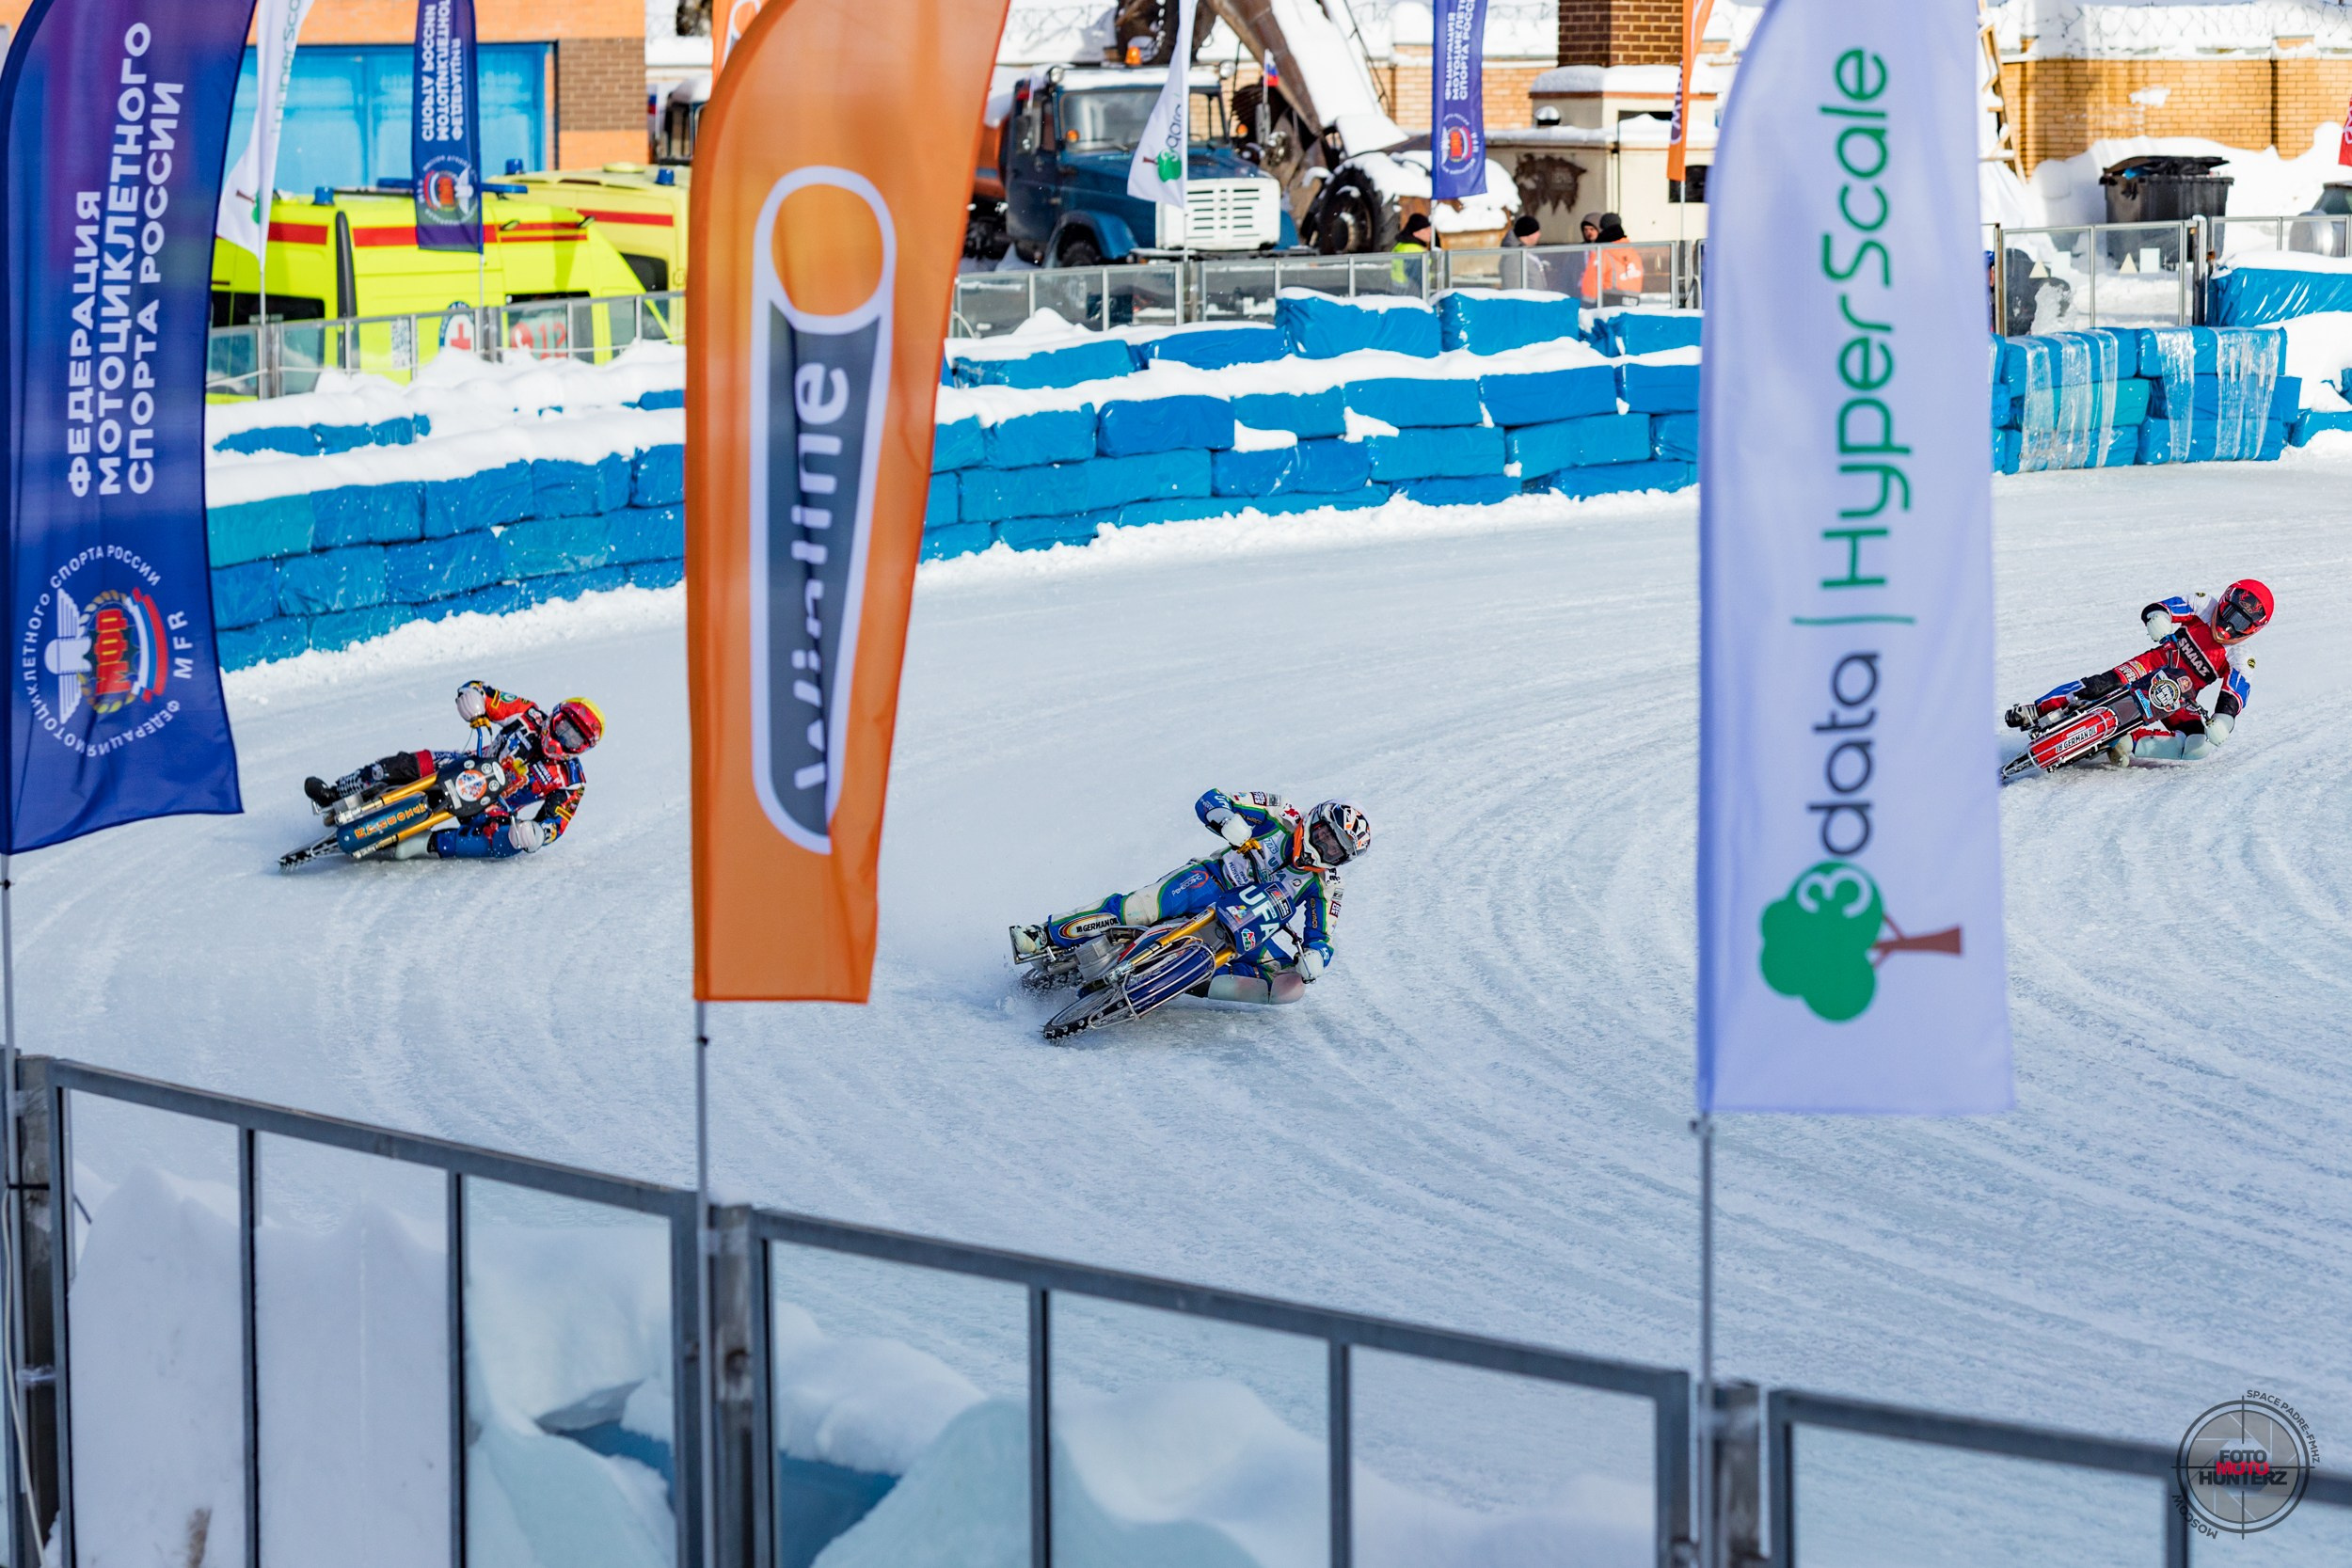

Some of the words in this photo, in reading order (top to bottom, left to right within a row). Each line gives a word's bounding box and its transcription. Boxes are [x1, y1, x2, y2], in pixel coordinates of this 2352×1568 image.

[1462, 0, 1476, 40] РОСС
[1459, 43, 1470, 101] СПОРТА
[139, 83, 183, 283] РОССИИ
[98, 23, 151, 495] МОТОЦИКЛЕТНОГО
[68, 192, 101, 497] ФЕДЕРАЦИЯ
[1820, 46, 1913, 589] HyperScale
[128, 299, 159, 494] СПОРТА
[50, 546, 103, 589] СПОРТА
[107, 545, 161, 586] РОССИИ
[167, 610, 193, 679] MFR
[23, 594, 87, 755] МОТОЦИКЛЕТНОГО
[87, 700, 180, 757] ФЕДЕРАЦИЯ
[2064, 733, 2089, 749] GERMAN
[1083, 918, 1110, 932] GERMAN
[1239, 884, 1279, 942] UFA
